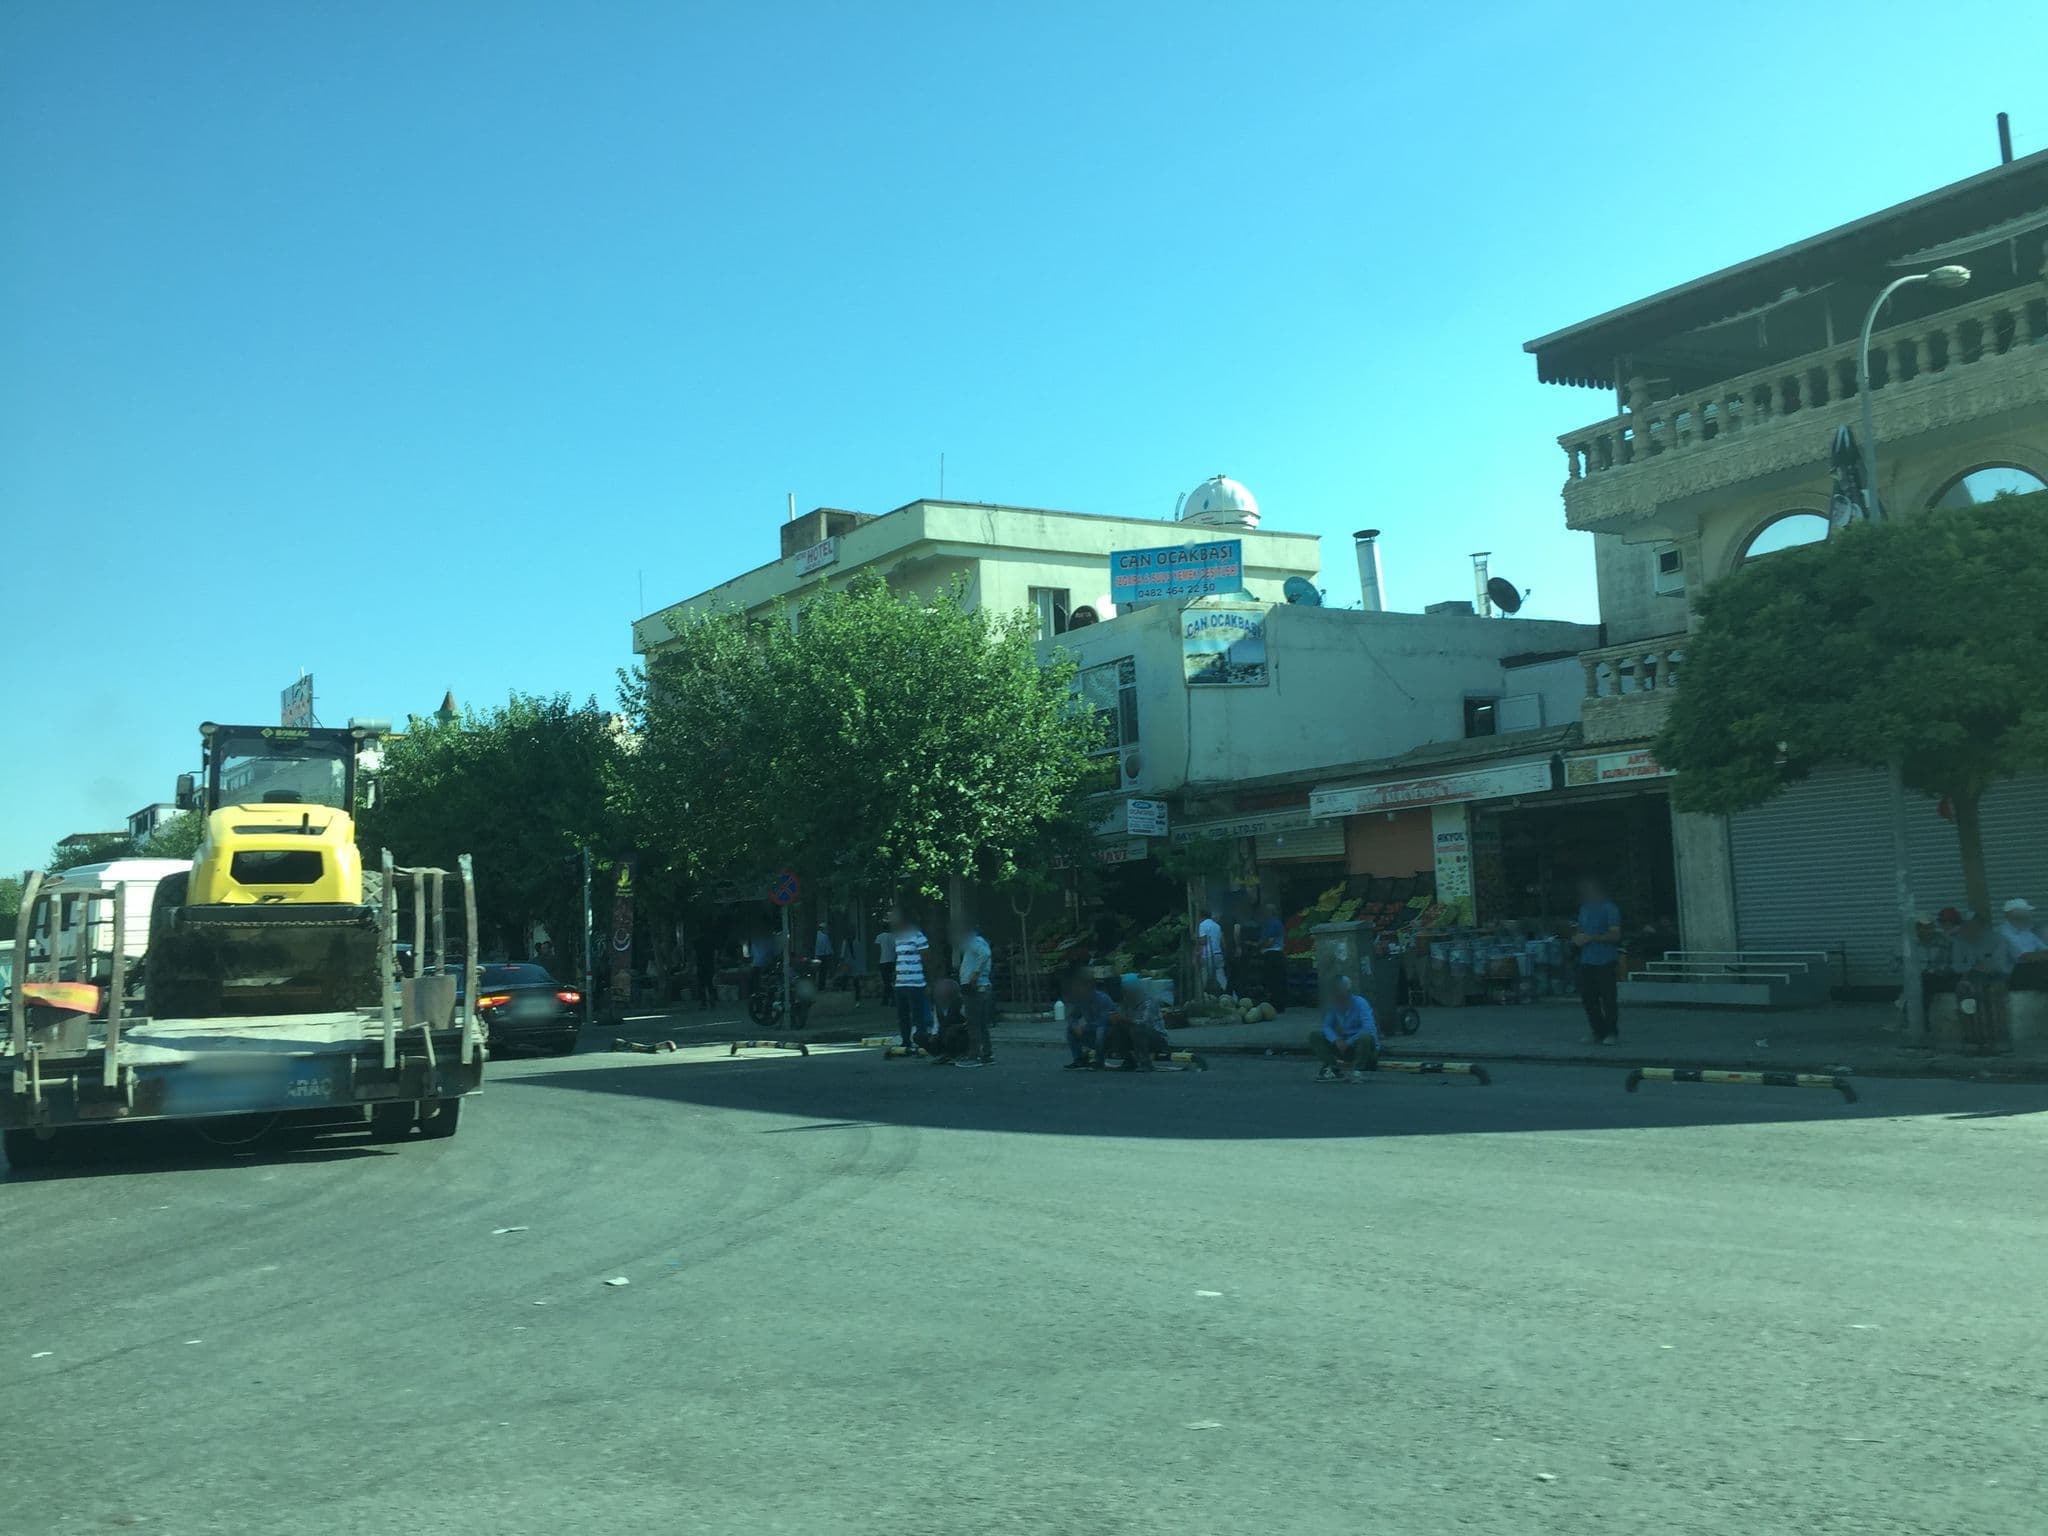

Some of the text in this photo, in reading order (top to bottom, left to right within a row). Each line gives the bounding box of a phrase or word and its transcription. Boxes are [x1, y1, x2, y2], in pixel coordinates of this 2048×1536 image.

[808, 541, 833, 562] HOTEL
[1120, 554, 1151, 568] CAN
[1138, 589, 1162, 598] 0482
[1187, 616, 1208, 637] CAN
[275, 729, 310, 737] BOMAC
